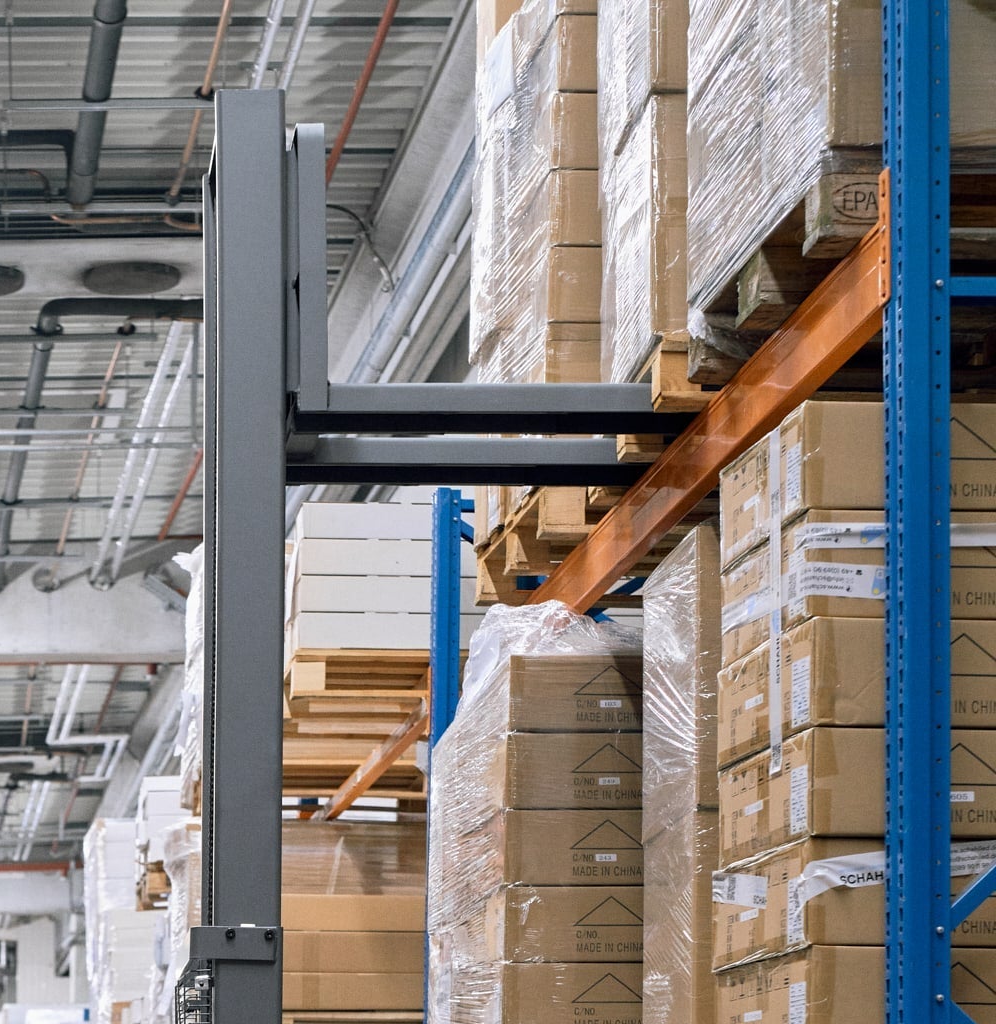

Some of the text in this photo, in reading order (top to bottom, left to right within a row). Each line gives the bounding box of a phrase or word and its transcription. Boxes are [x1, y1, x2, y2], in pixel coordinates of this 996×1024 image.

[576, 711, 602, 722] MADE
[606, 712, 614, 722] IN
[573, 790, 599, 800] MADE
[602, 790, 613, 800] IN
[572, 866, 642, 877] MADE IN CHINA
[576, 942, 643, 953] MADE IN CHINA
